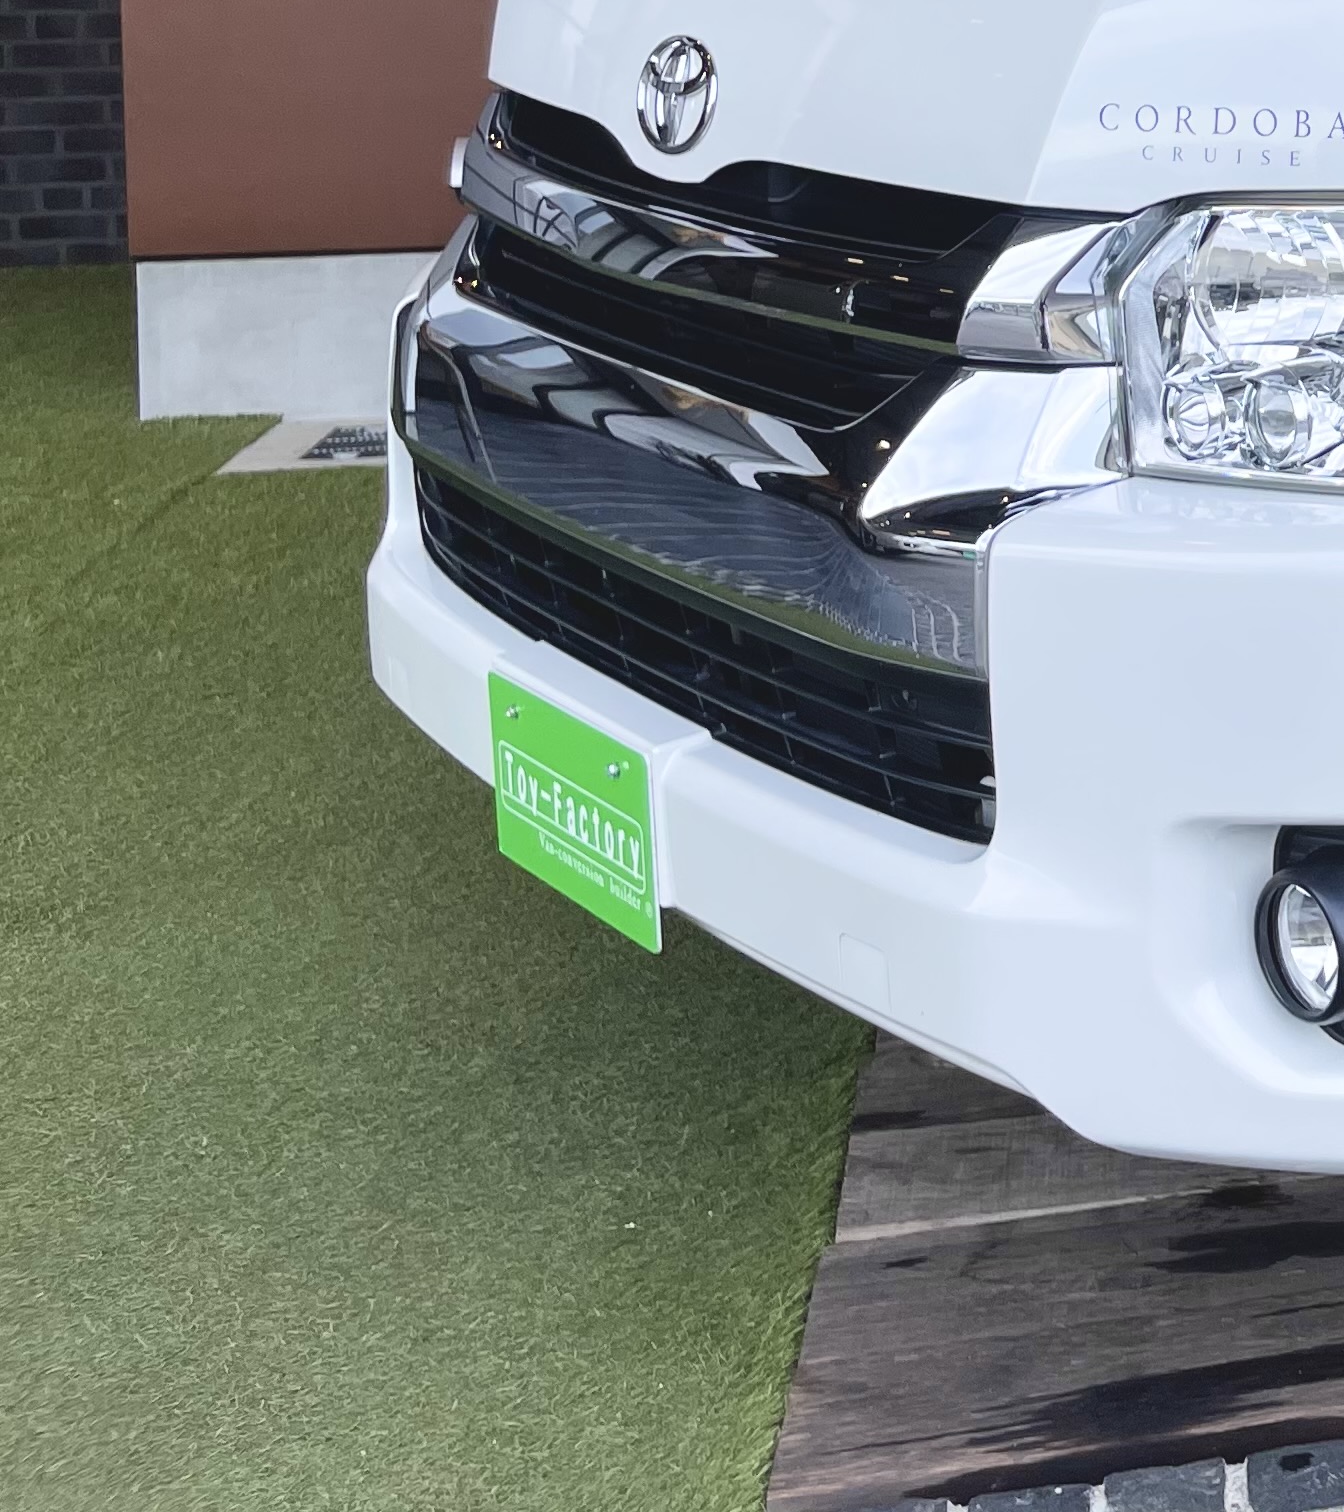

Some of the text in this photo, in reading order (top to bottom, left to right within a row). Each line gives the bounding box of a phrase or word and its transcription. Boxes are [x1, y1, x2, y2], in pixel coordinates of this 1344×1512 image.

[1142, 144, 1301, 167] CRUISE
[504, 751, 641, 879] Toy-Factory
[538, 831, 641, 911] Van-conversion builder
